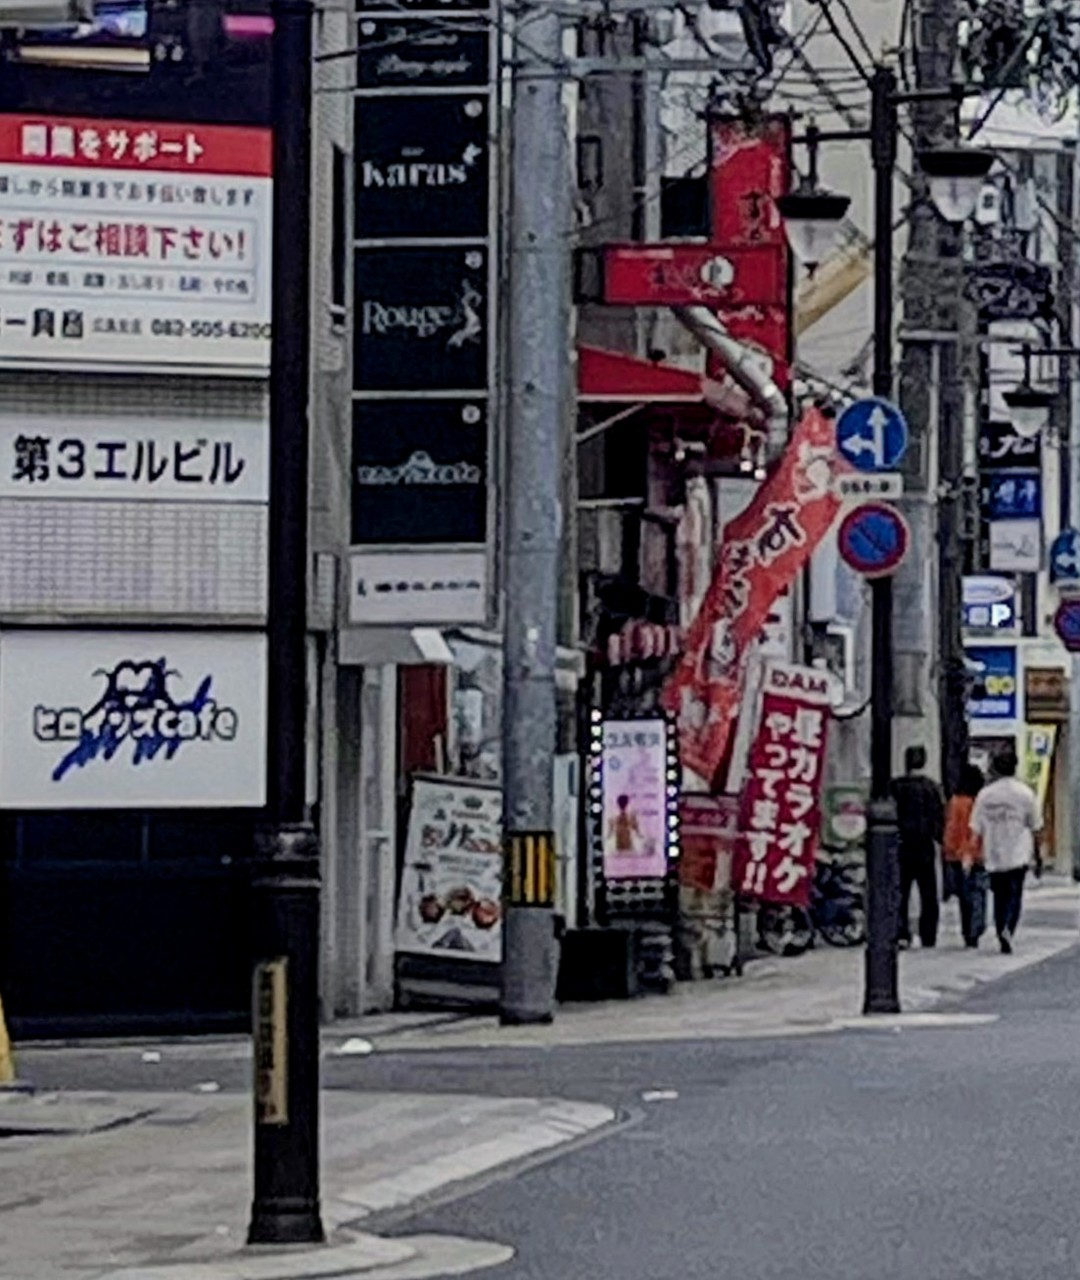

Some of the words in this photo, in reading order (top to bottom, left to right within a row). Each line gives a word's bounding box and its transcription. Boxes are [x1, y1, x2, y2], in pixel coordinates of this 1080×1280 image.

[0, 219, 246, 261] ずはご相談下さい!
[12, 435, 245, 485] 第3エルビル
